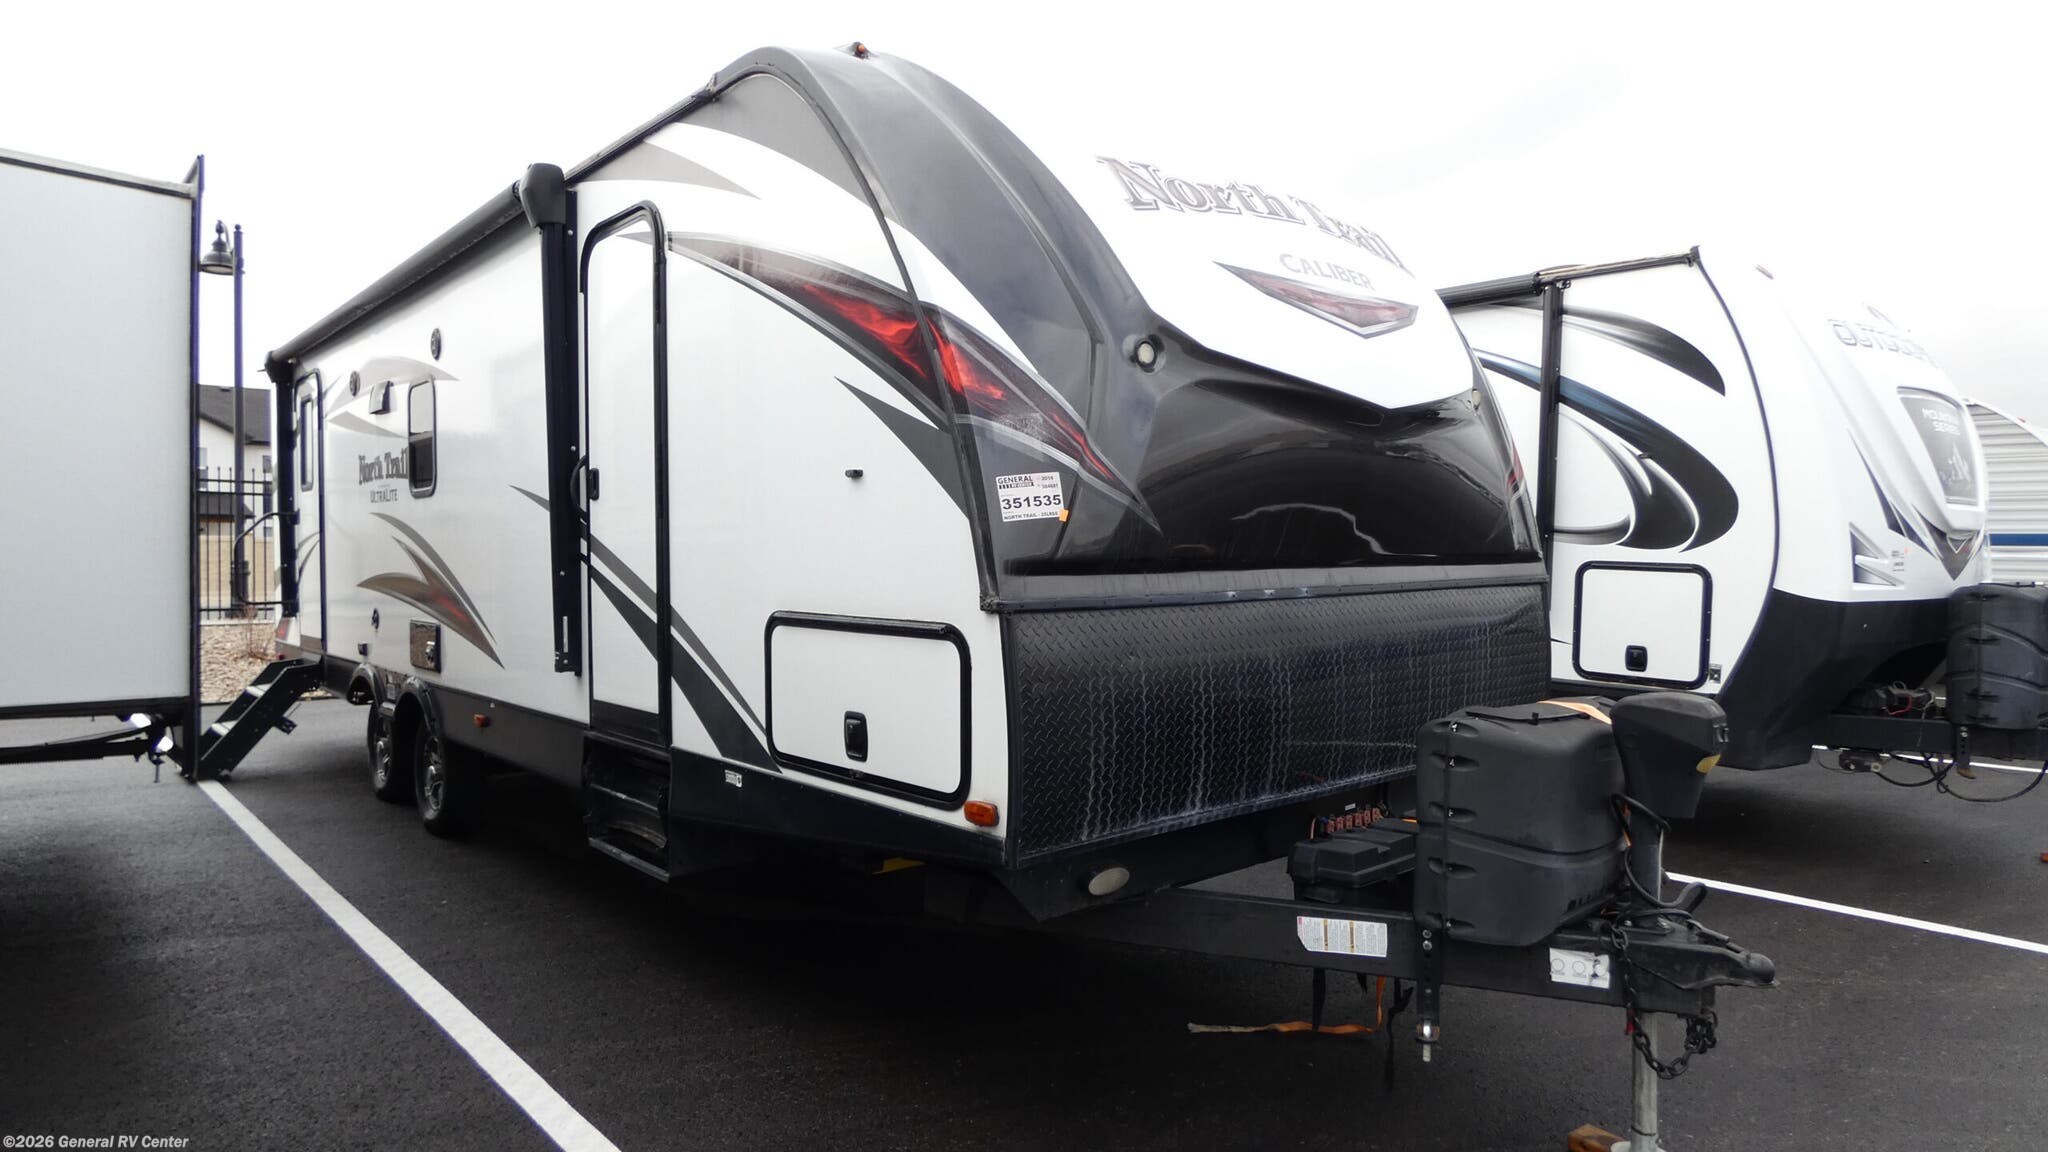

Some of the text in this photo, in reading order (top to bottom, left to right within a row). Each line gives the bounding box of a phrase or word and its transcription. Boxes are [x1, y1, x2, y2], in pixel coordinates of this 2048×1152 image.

[1096, 155, 1416, 279] North Trail
[1279, 252, 1377, 292] CALIBER
[358, 446, 409, 485] North Trail
[998, 475, 1033, 484] GENERAL
[1002, 494, 1061, 510] 351535
